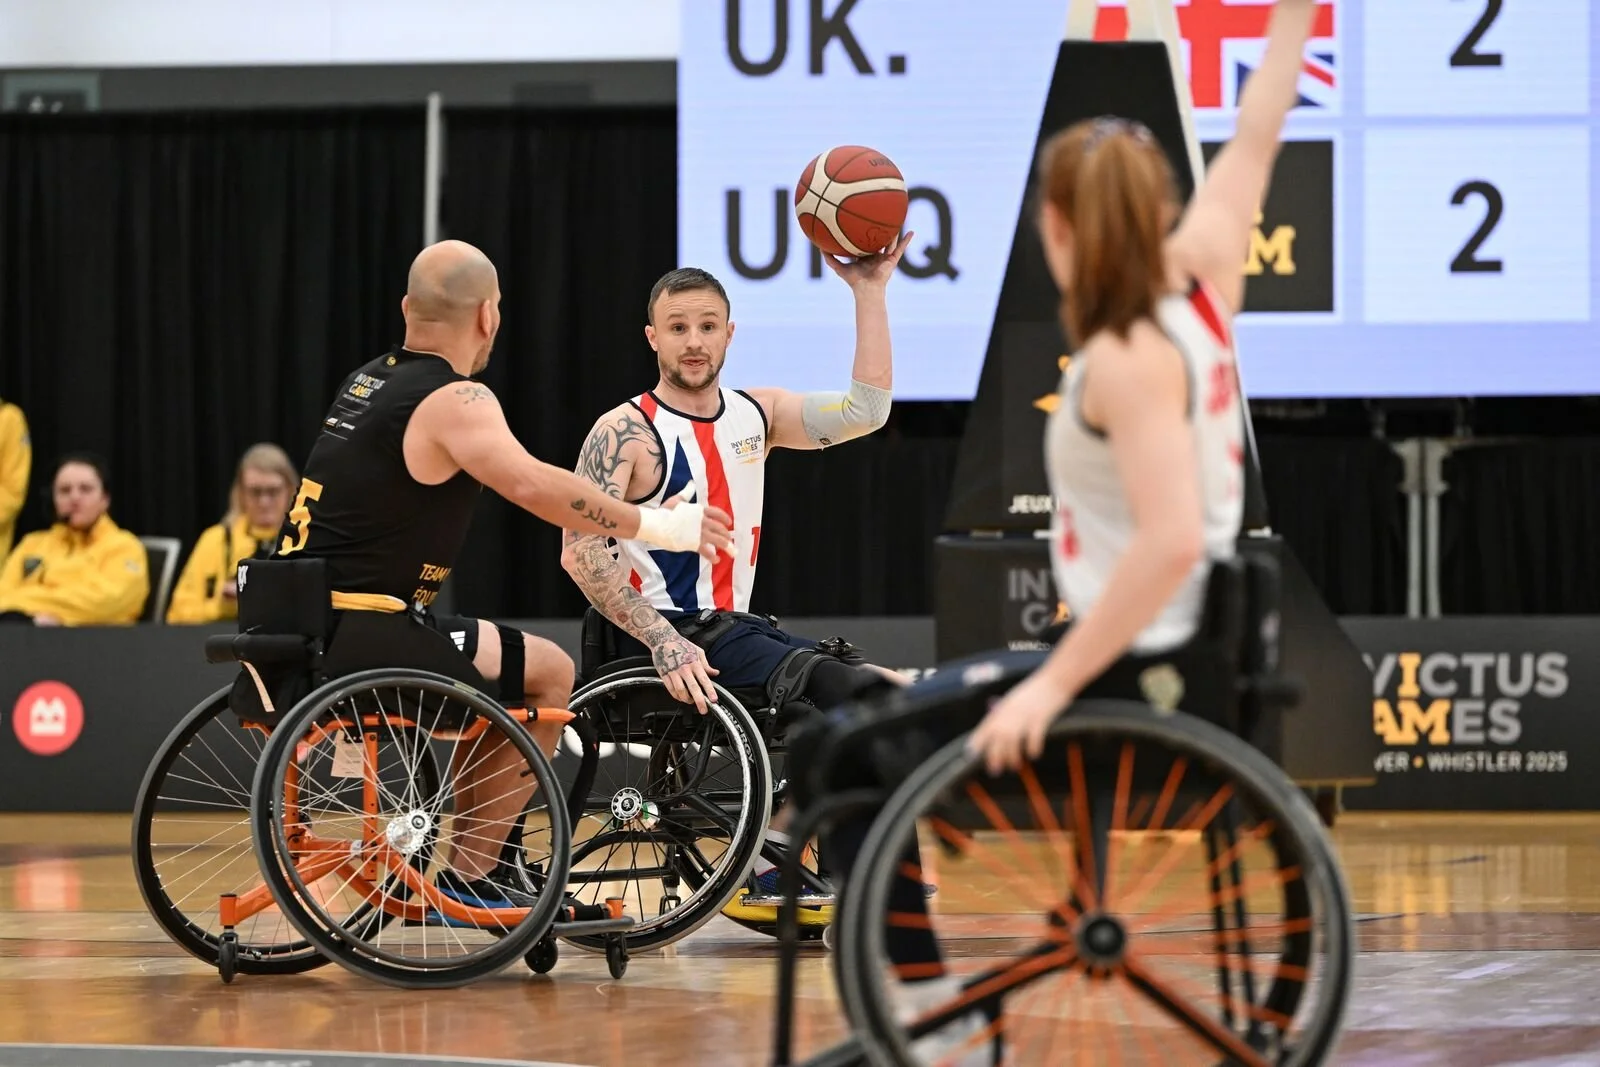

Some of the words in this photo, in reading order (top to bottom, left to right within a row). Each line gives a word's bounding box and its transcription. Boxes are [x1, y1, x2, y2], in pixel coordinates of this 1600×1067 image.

[725, 0, 907, 76] UK.
[1449, 0, 1502, 67] 2
[725, 186, 960, 281] UQ
[1449, 180, 1503, 273] 2
[730, 435, 762, 449] INVICTUS
[1362, 652, 1569, 698] VICTUS
[1373, 698, 1522, 745] AMES
[1373, 751, 1411, 773] VER
[1426, 751, 1522, 773] WHISTLER
[1525, 751, 1568, 773] 2025
